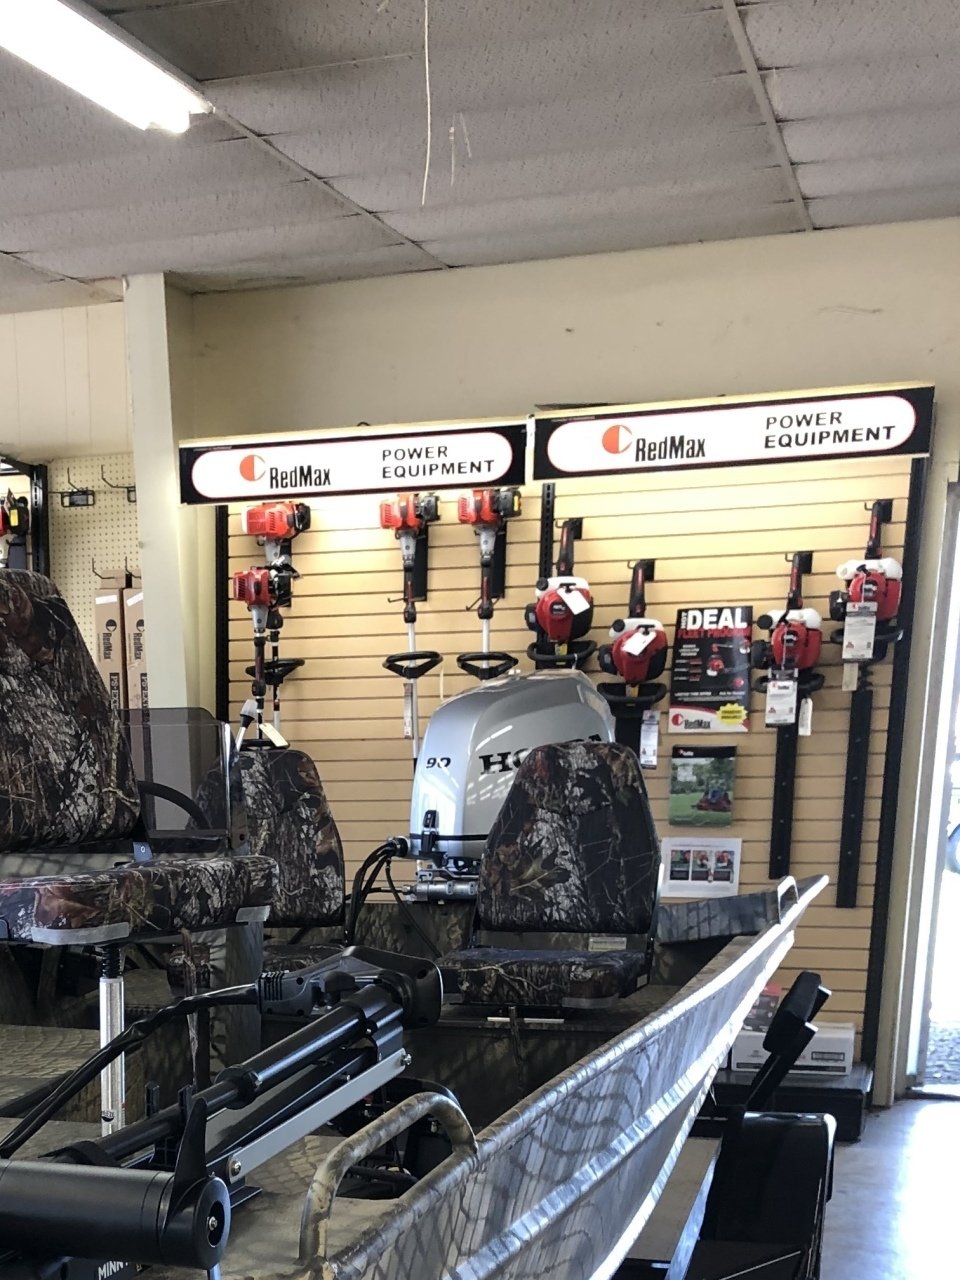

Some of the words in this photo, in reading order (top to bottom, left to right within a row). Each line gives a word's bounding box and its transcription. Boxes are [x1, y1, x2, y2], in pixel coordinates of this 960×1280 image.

[766, 411, 842, 430] POWER
[764, 425, 895, 448] EQUIPMENT
[382, 446, 448, 461] POWER
[635, 435, 706, 462] RedMax
[270, 465, 331, 489] RedMax
[382, 460, 495, 479] EQUIPMENT
[686, 608, 748, 630] DEAL
[102, 632, 113, 660] RedMax
[133, 632, 144, 660] RedMax
[426, 757, 451, 769] 90
